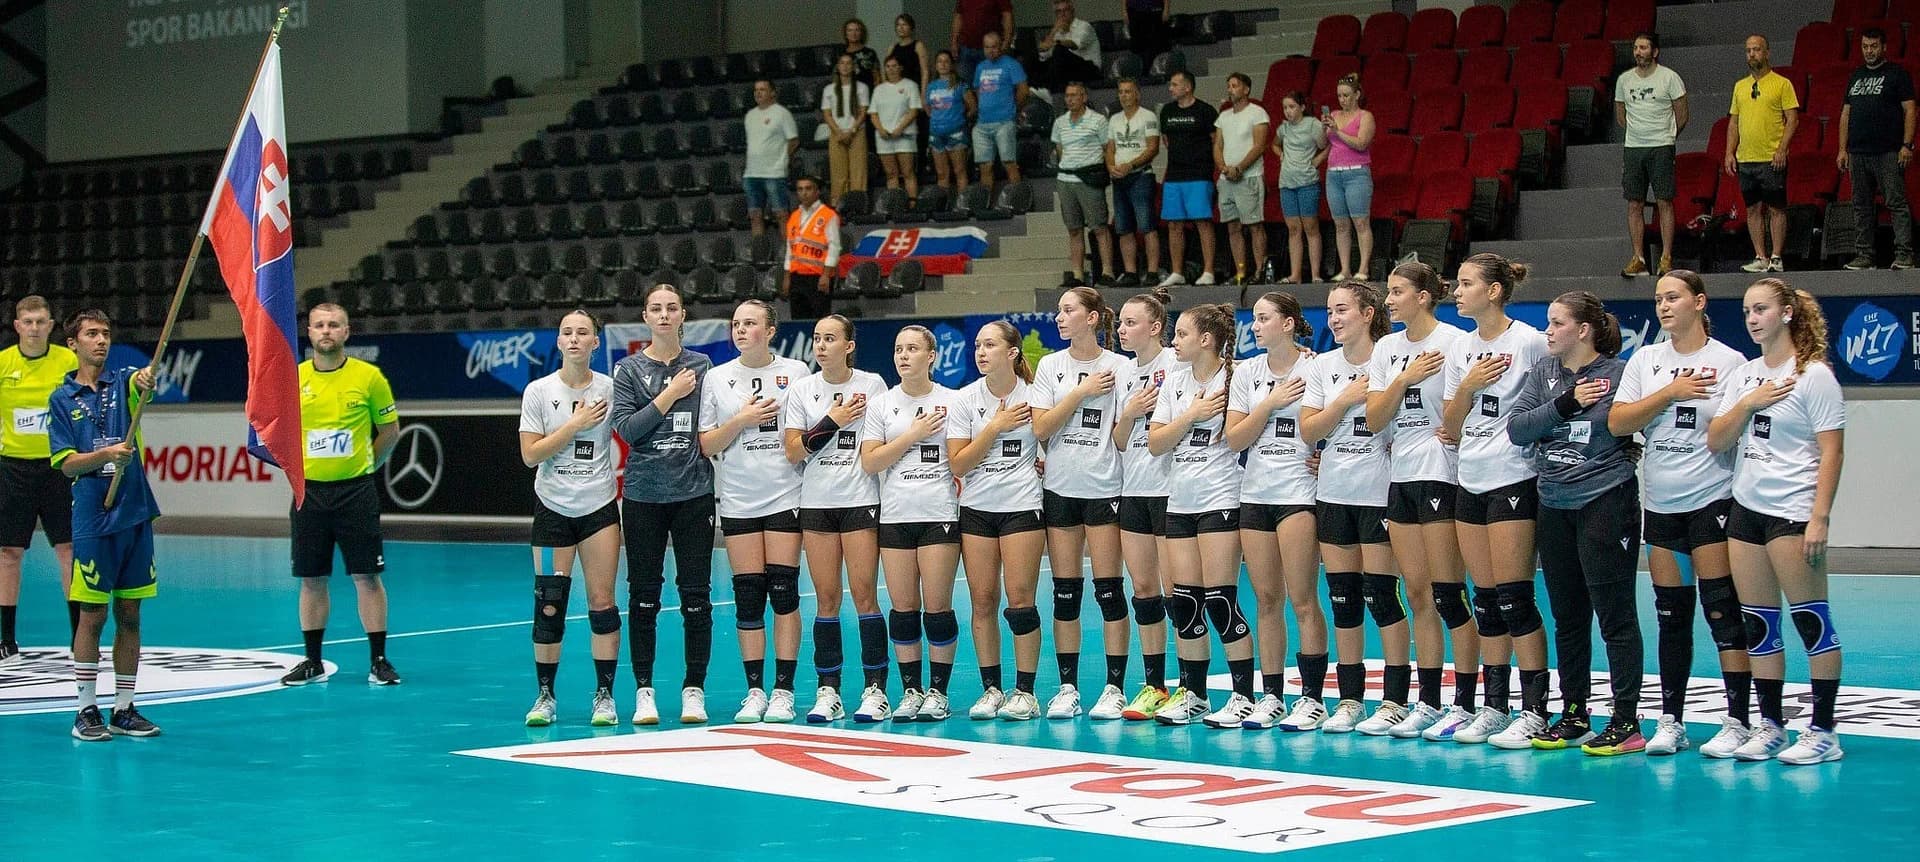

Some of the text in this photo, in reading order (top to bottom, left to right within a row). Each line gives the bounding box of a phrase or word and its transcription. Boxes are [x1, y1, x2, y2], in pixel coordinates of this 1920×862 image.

[126, 15, 182, 47] SPOR
[466, 331, 543, 379] CHEER
[751, 377, 763, 400] 2
[17, 415, 35, 427] EHF
[310, 432, 350, 454] EHF TV
